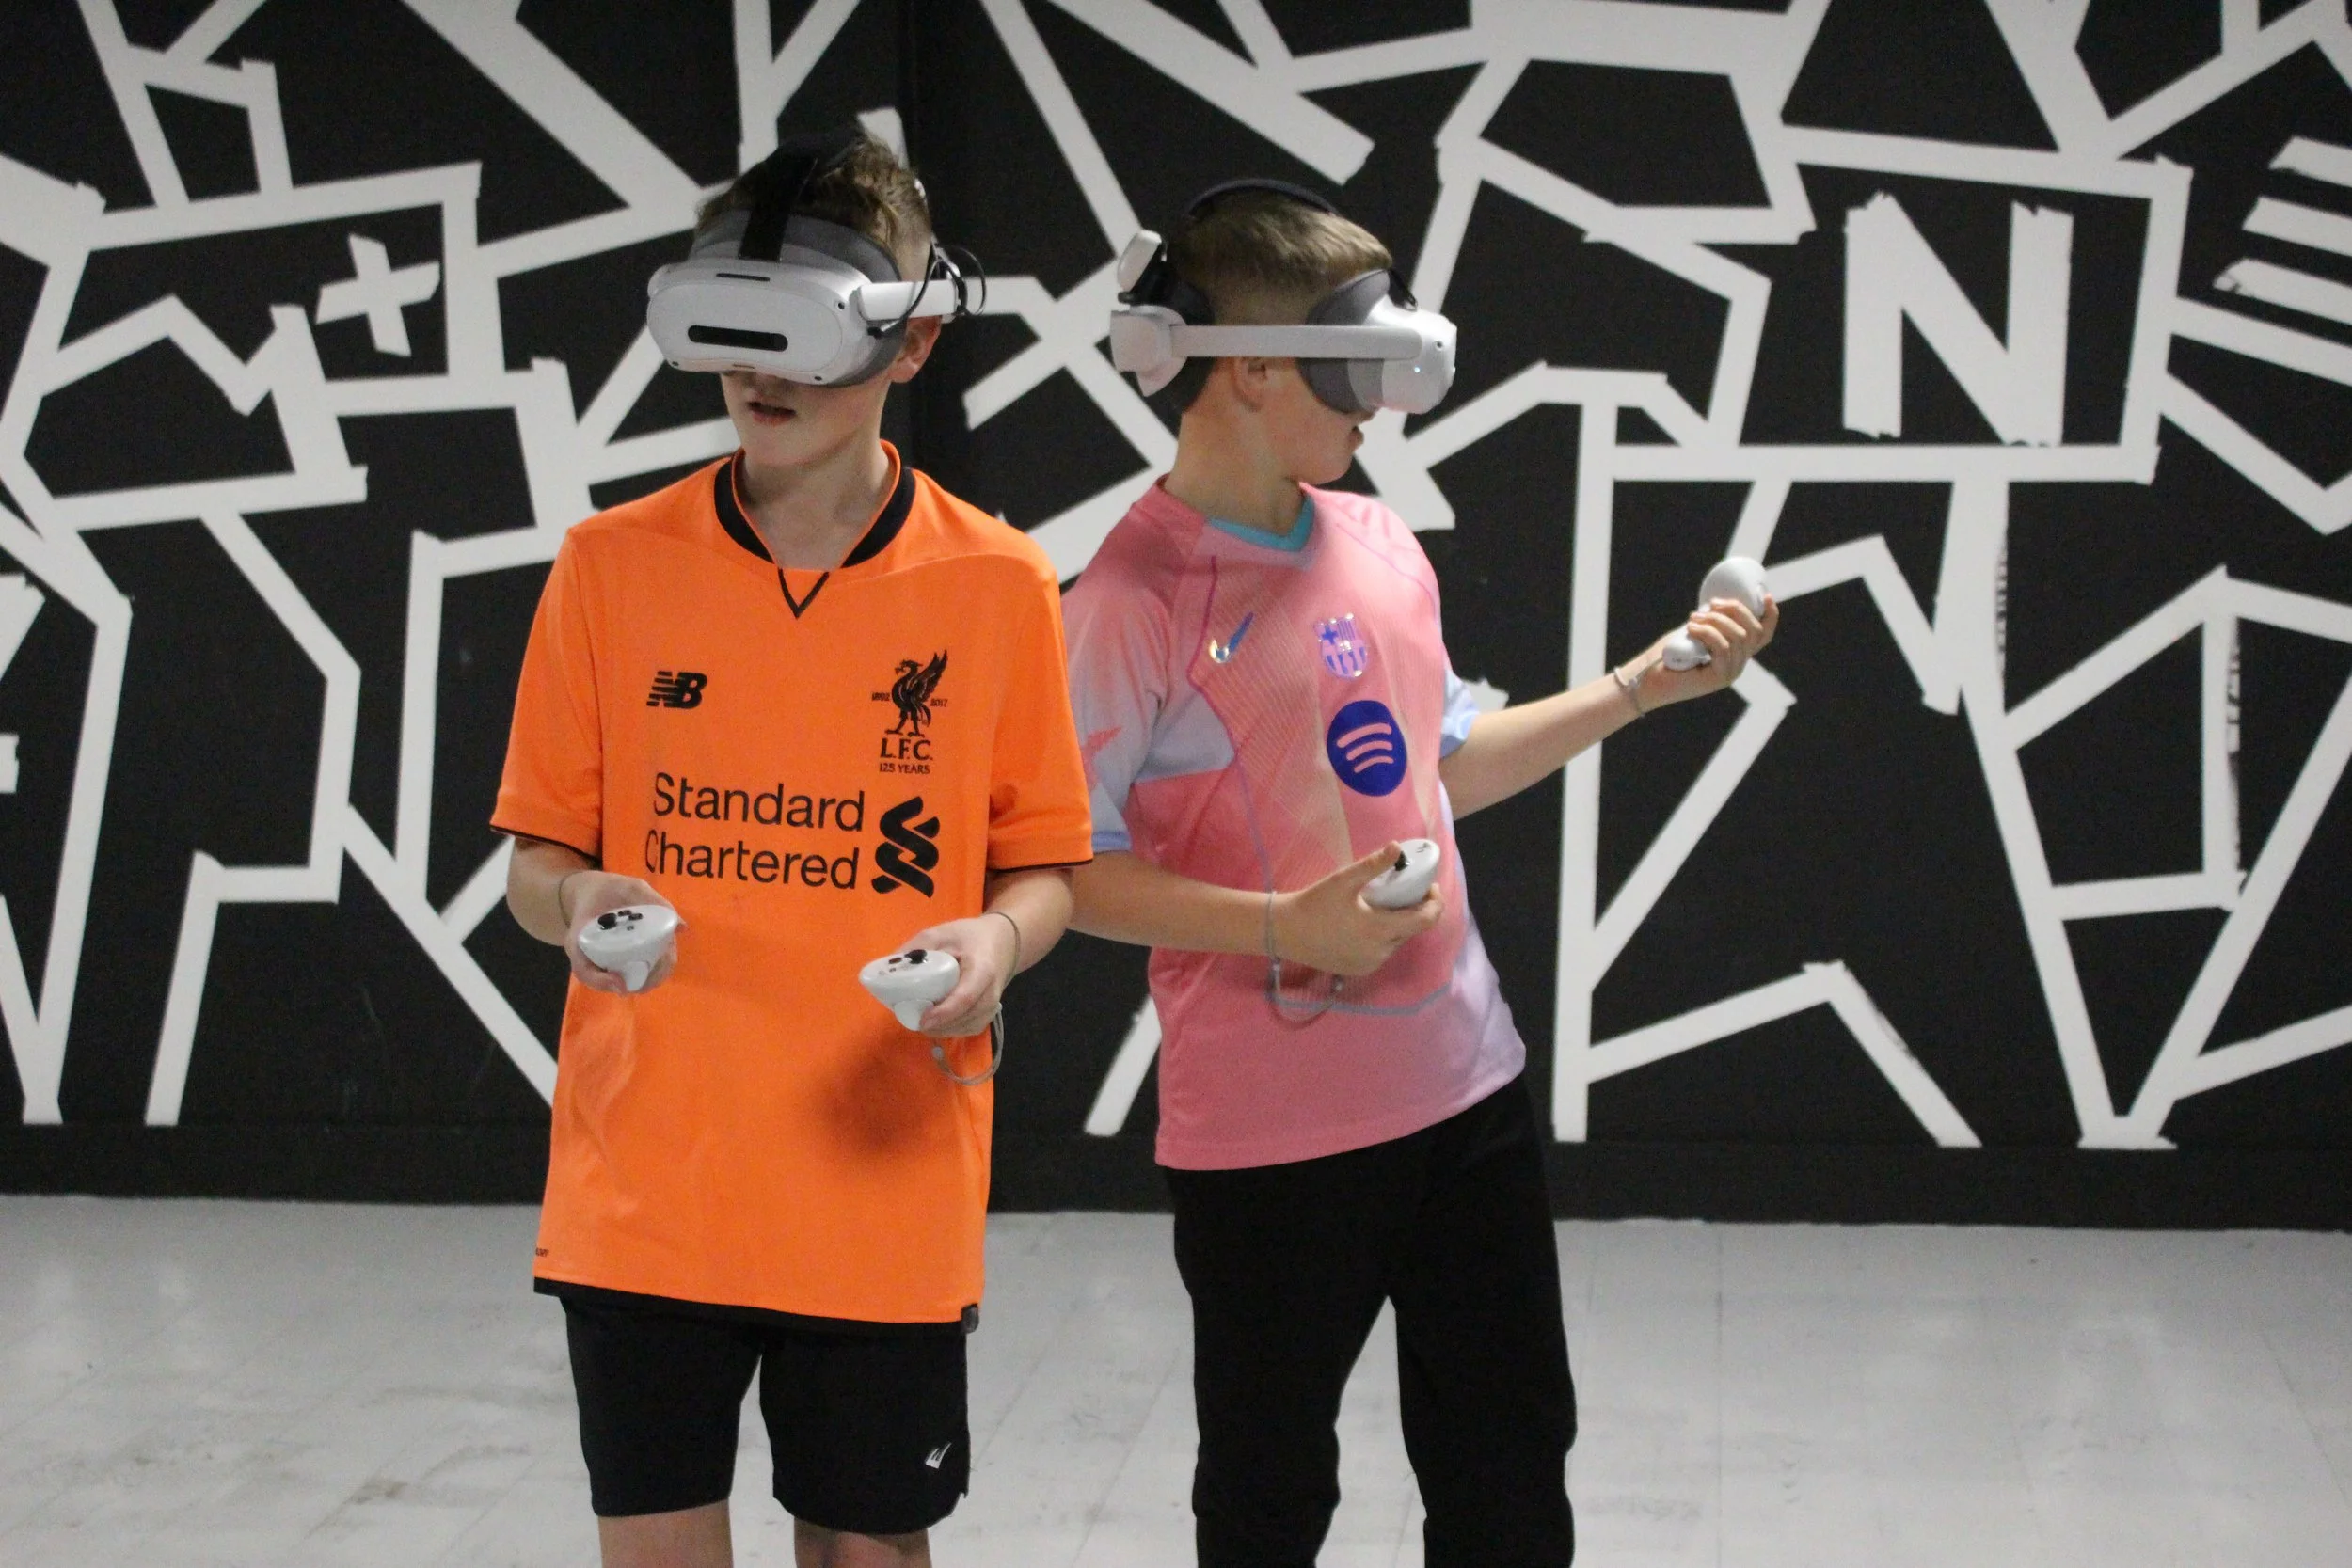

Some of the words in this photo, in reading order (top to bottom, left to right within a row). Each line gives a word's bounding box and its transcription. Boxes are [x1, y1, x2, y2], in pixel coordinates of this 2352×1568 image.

[879, 763, 896, 773] 125
[898, 764, 931, 775] YEARS
[880, 737, 934, 761] L.F.C.
[653, 772, 865, 832] Standard
[644, 829, 860, 890] Chartered
